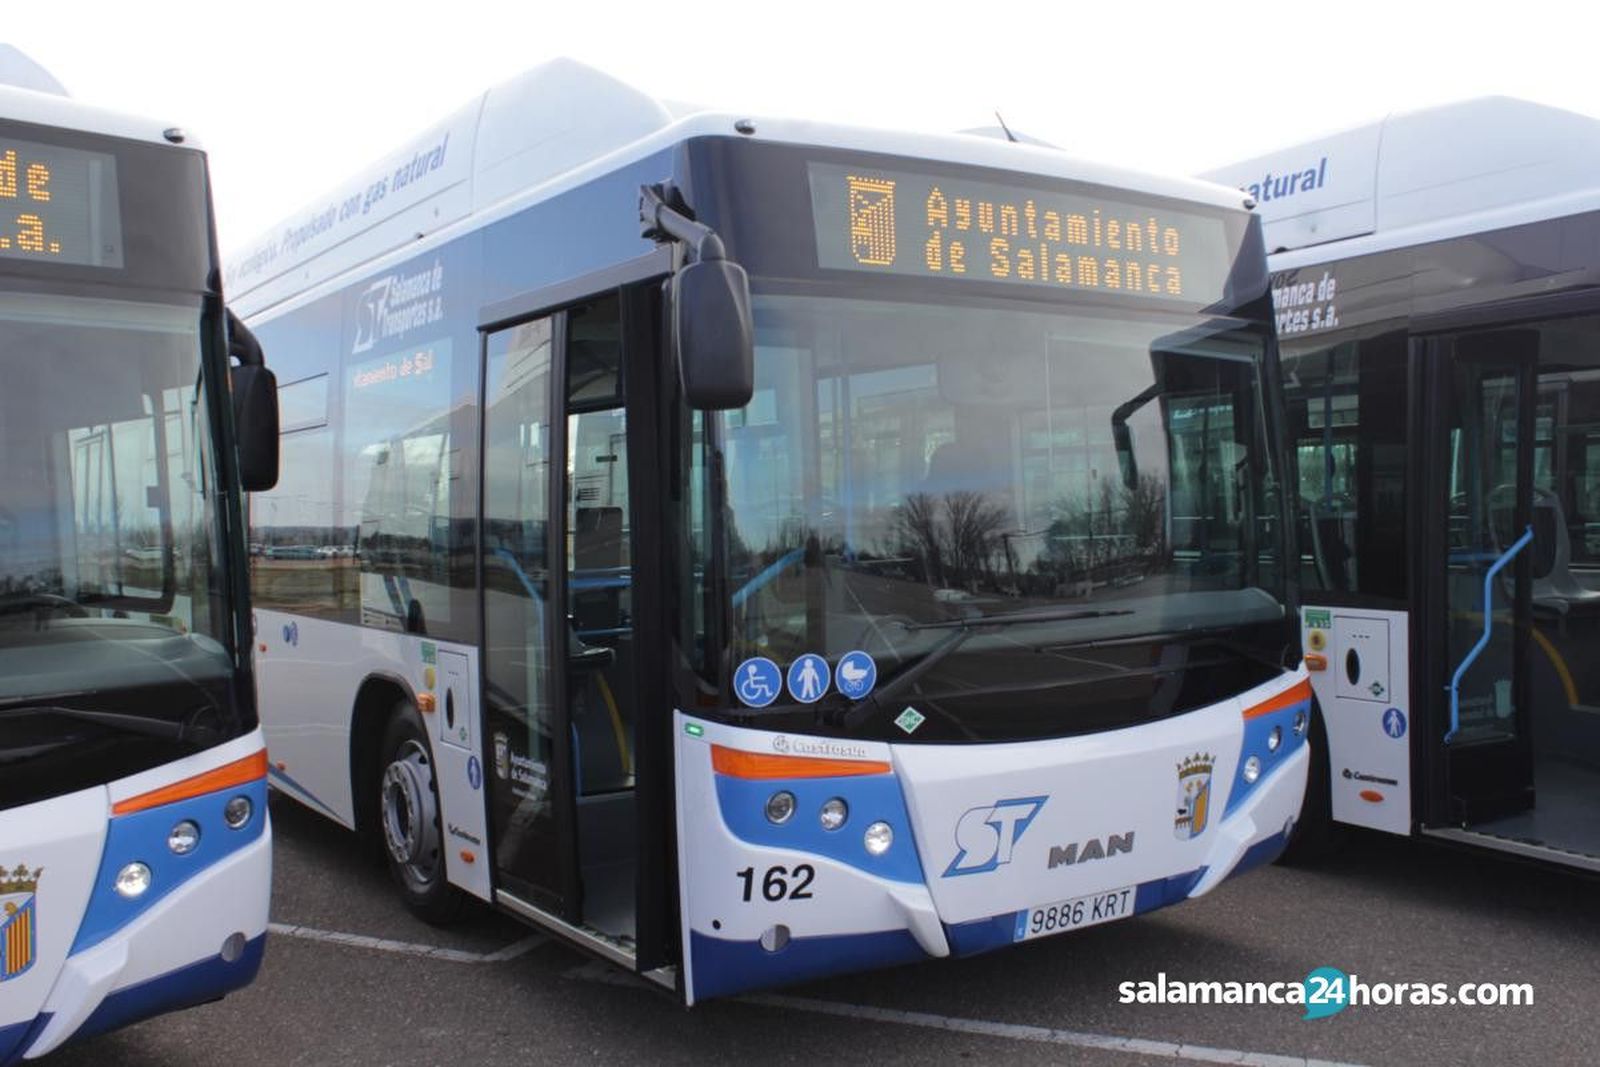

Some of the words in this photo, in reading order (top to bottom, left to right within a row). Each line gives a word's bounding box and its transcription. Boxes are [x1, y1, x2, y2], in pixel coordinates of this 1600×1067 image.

[0, 149, 51, 201] de
[362, 176, 389, 215] gas
[392, 130, 450, 192] natural
[1239, 157, 1327, 203] atural
[926, 185, 1182, 257] Ayuntamiento
[925, 230, 965, 273] de
[989, 236, 1184, 296] Salamanca
[1317, 271, 1336, 302] de
[1311, 304, 1339, 330] s.a.
[941, 795, 1050, 878] ST
[1047, 831, 1136, 870] MAN
[736, 863, 816, 902] 162
[1031, 901, 1085, 934] 9886
[1090, 889, 1131, 921] KRT
